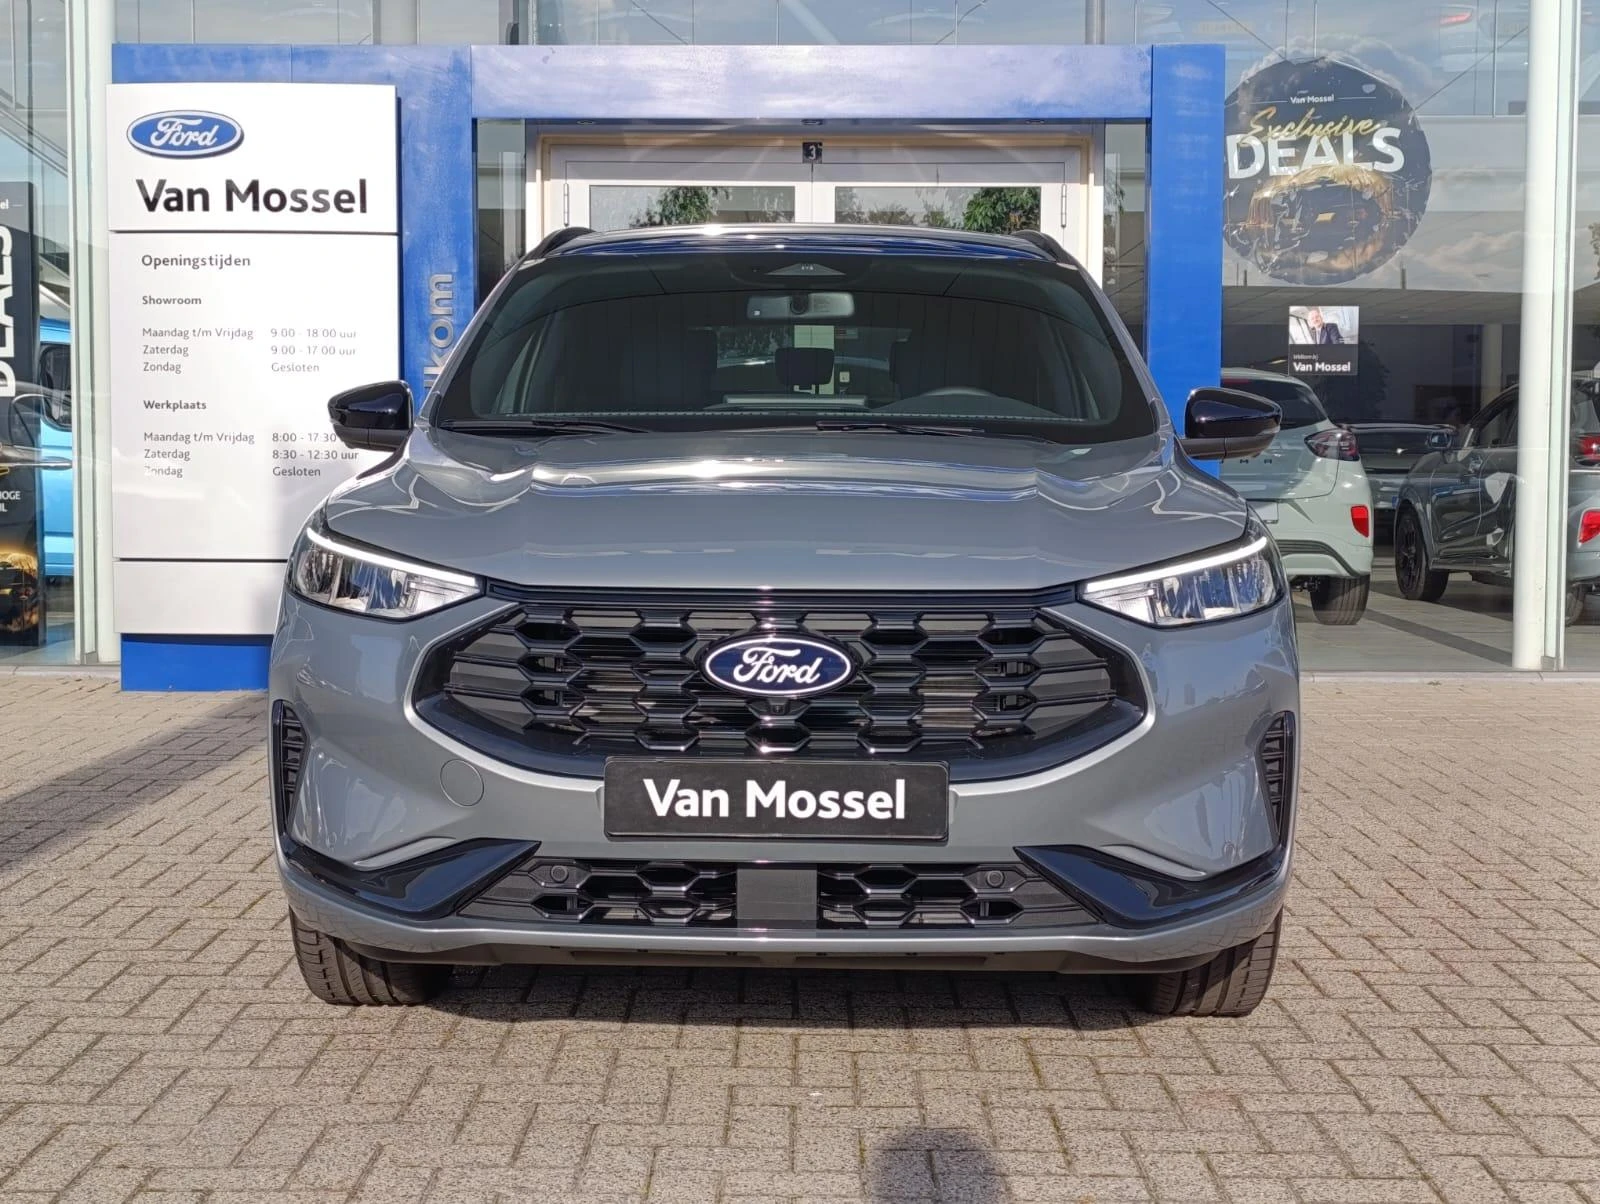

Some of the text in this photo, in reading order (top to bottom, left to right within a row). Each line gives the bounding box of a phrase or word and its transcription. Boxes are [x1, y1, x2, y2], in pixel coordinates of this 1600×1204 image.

[1290, 94, 1335, 104] Van Mossel
[149, 117, 220, 148] Ford
[1238, 105, 1381, 147] Exclusive
[809, 145, 816, 160] 3
[1226, 127, 1406, 179] DEALS
[136, 178, 368, 214] Van Mossel
[141, 254, 251, 270] Openingstijden
[142, 295, 202, 306] Showroom
[142, 328, 190, 340] Maandag
[192, 328, 212, 338] t/m
[215, 328, 254, 340] Vrijdag
[270, 328, 296, 338] 900
[306, 328, 337, 338] 1800
[423, 273, 454, 388] kom
[142, 345, 189, 357] Zaterdag
[270, 345, 296, 355] 900
[307, 345, 336, 355] 1700
[143, 362, 320, 374] Zondag Gesloten
[1293, 362, 1351, 372] Van Mossel
[143, 400, 207, 412] Werkplaats
[144, 432, 191, 444] Maandag
[194, 432, 213, 442] t/m
[218, 432, 255, 445] Vrijdag
[272, 432, 297, 442] 8:00
[308, 432, 337, 442] 1730
[144, 449, 190, 461] Zaterdag
[272, 449, 297, 459] 8:30
[308, 450, 338, 460] 12:30
[341, 452, 357, 460] uur
[272, 466, 321, 477] Gesloten
[733, 647, 824, 685] Ford
[643, 778, 906, 820] Van Mossel
